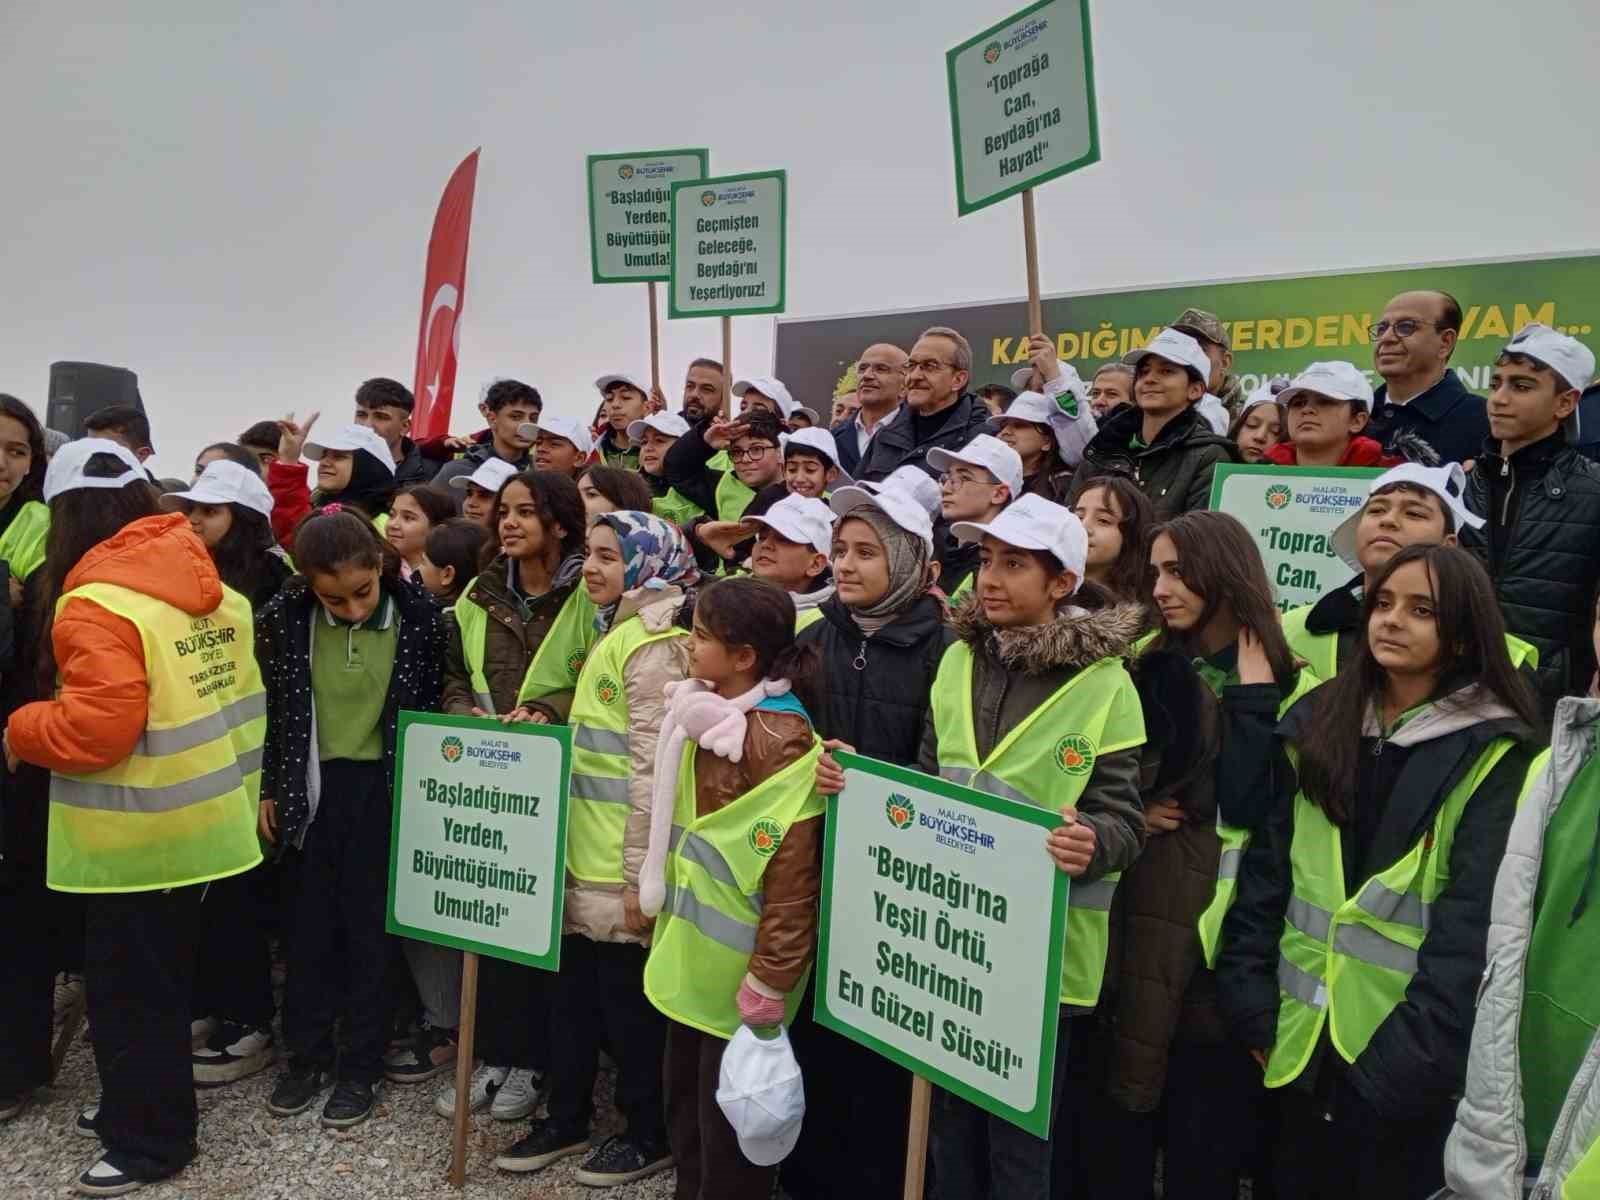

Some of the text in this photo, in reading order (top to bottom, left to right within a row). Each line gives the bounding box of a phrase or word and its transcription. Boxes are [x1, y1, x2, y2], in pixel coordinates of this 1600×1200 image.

[986, 53, 1050, 94] "Toprağa
[1003, 92, 1036, 117] Can,
[984, 107, 1061, 155] Beydağı'na
[999, 141, 1049, 177] Hayat!"
[605, 187, 671, 206] "Başladığı
[625, 209, 671, 225] Yerden,
[696, 214, 759, 234] Geçmişten
[607, 230, 671, 249] Büyüttüğü
[698, 237, 757, 256] Geleceğe,
[697, 261, 758, 279] Beydağı'nı
[689, 281, 765, 301] Yeşertiyoruz!
[992, 321, 1161, 366] KADIĞIM
[1223, 314, 1371, 351] ERDEN
[1276, 563, 1322, 593] Can,
[419, 778, 540, 817] "Başladığımız
[919, 812, 995, 849] BÜYÜKŞEHİR
[936, 808, 977, 826] MALATYA
[443, 817, 508, 855] Yerden,
[413, 849, 538, 896] Büyüttüğümüz
[868, 845, 1008, 924] "Beydağı'na
[434, 890, 509, 928] Umutla!"
[873, 890, 993, 974] Yeşil Örtü,
[876, 940, 983, 1017] Şehrimin
[838, 969, 1023, 1081] En Güzel Süsü!"
